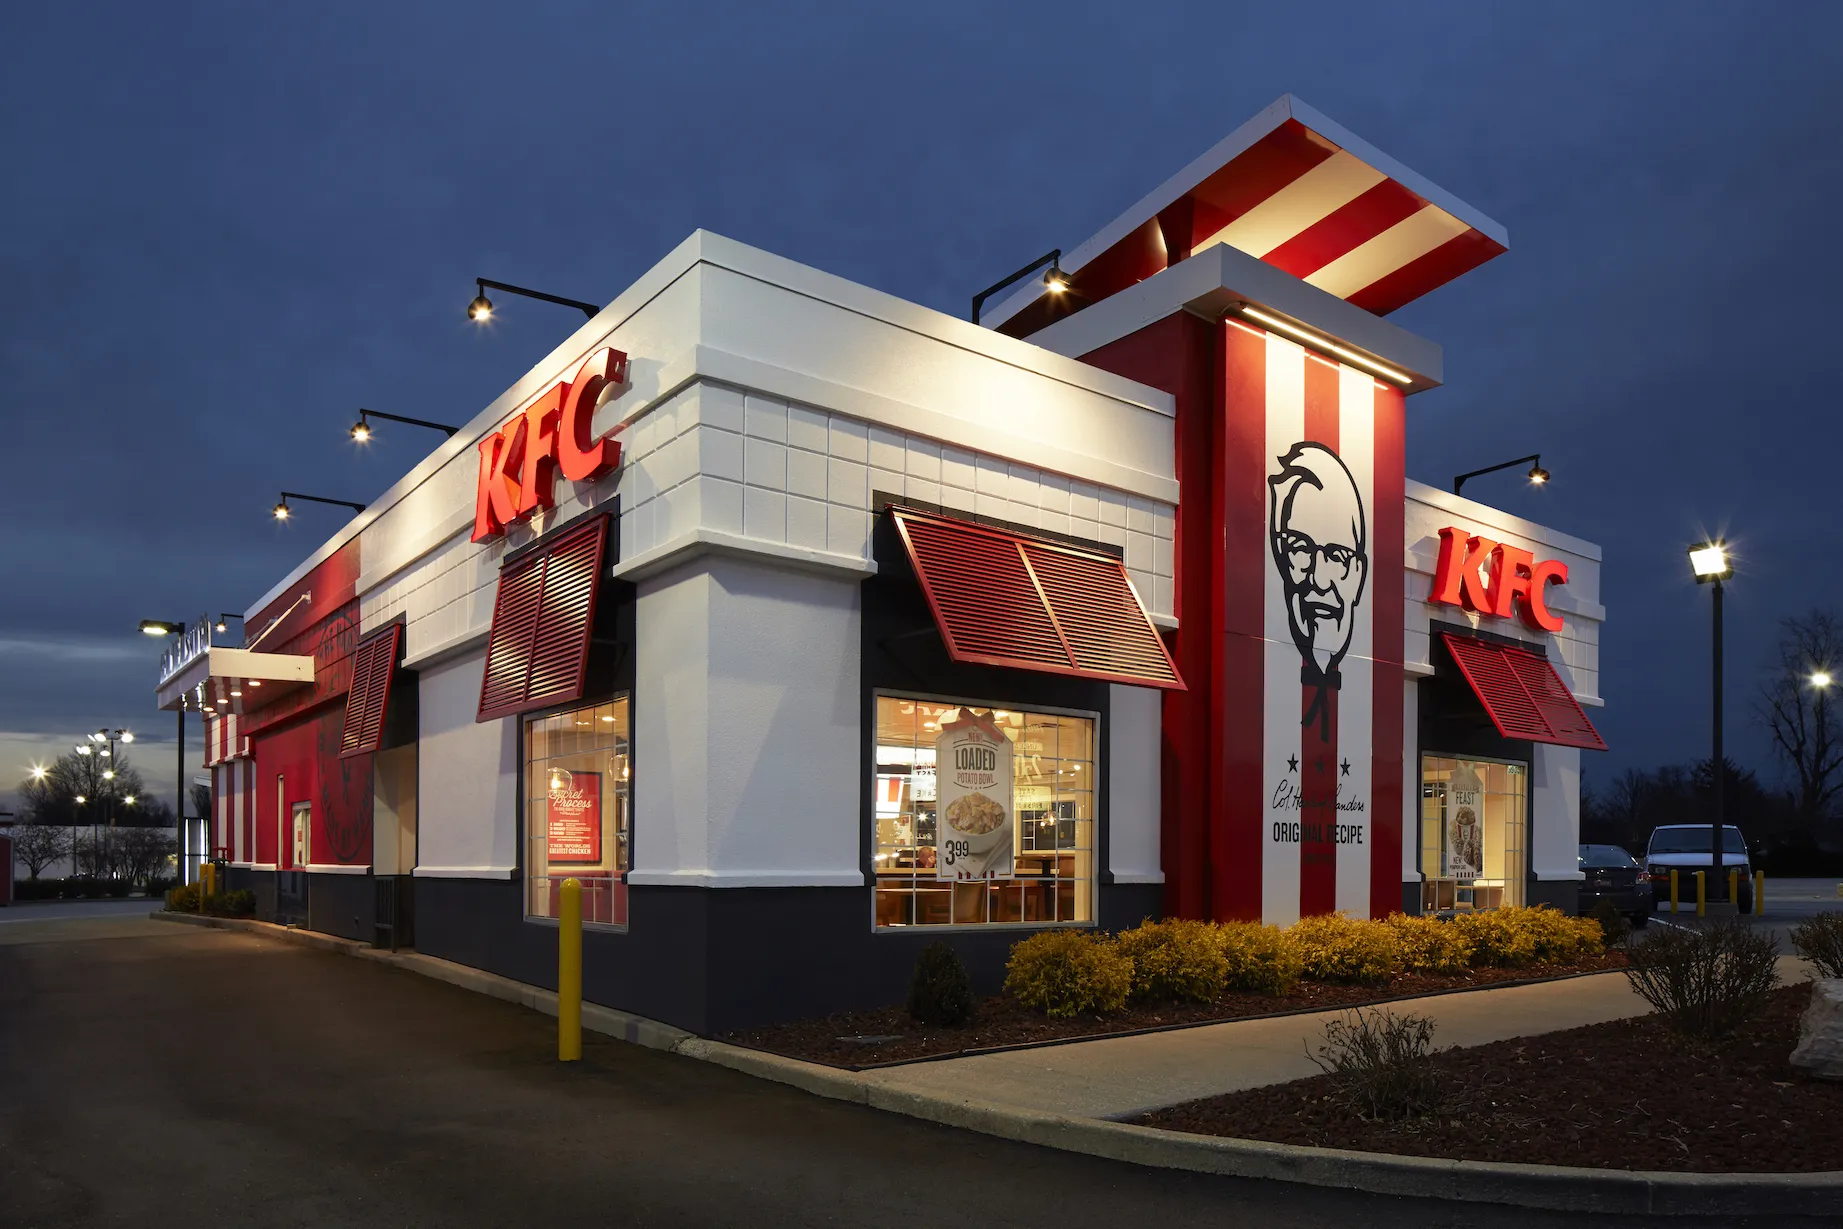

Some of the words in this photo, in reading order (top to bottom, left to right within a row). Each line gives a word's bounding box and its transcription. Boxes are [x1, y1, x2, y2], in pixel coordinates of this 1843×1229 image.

[471, 346, 628, 544] KFC
[1428, 526, 1568, 632] KFC
[955, 747, 996, 771] LOADED
[957, 773, 978, 784] POTATO
[978, 774, 994, 784] BOWL
[553, 797, 592, 808] Process
[1456, 792, 1475, 805] FEAST
[1273, 821, 1324, 843] ORIGINAL
[1327, 823, 1363, 844] RECIPE
